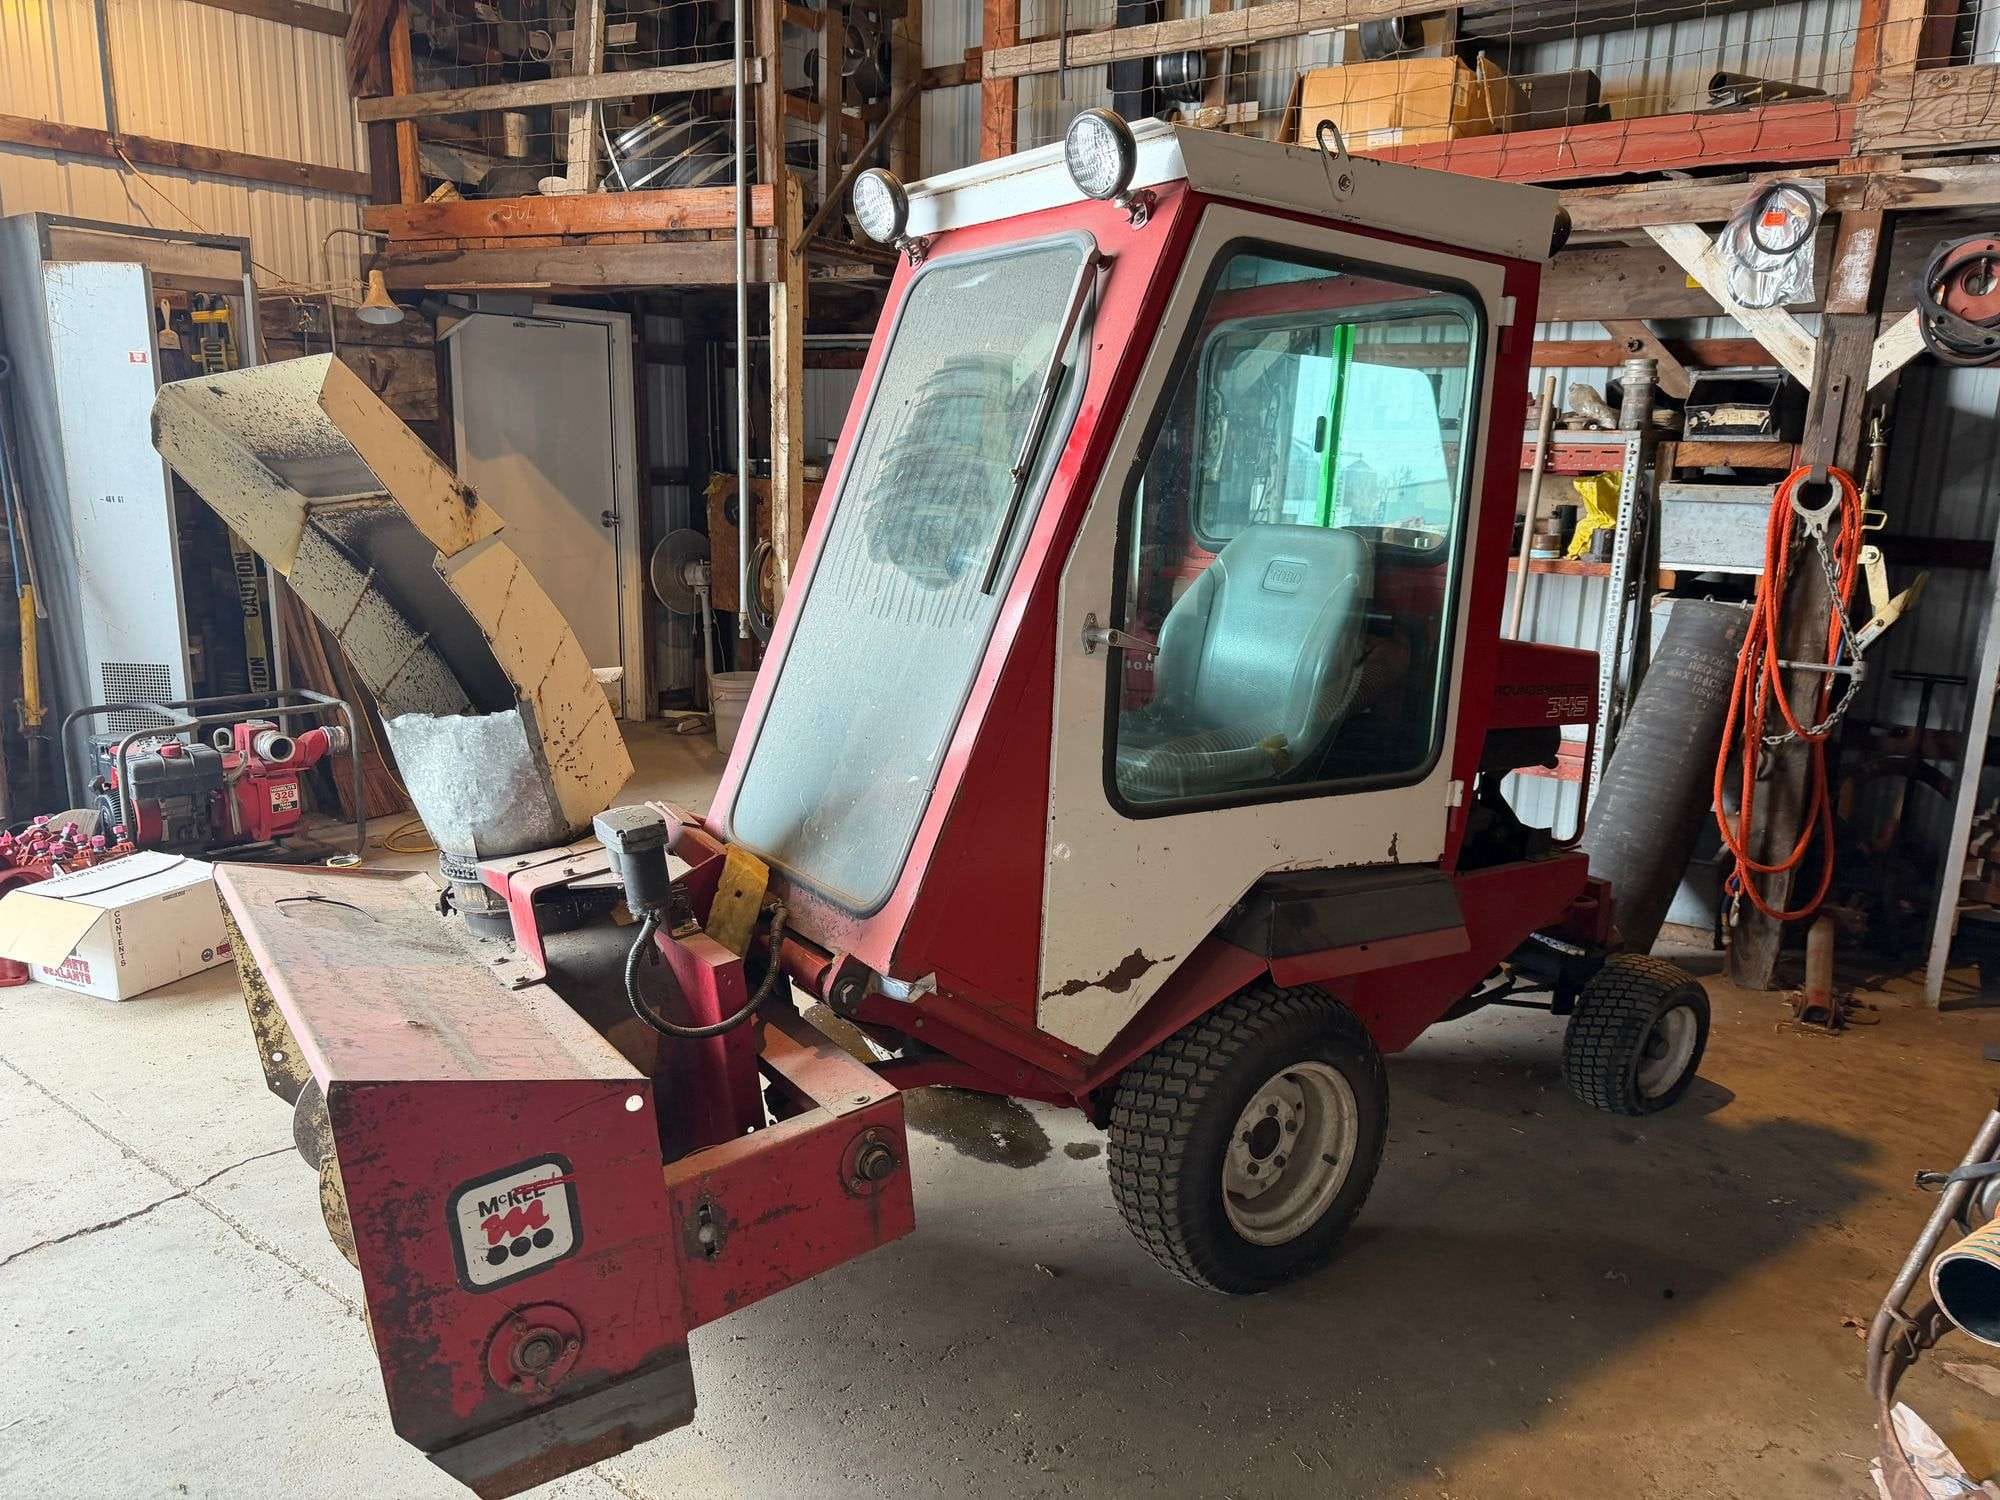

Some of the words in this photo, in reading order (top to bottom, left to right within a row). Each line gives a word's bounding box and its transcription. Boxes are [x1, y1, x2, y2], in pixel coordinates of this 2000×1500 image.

[234, 552, 260, 618] CAUTION
[1545, 696, 1588, 718] 345
[113, 910, 126, 967] CONTENTS
